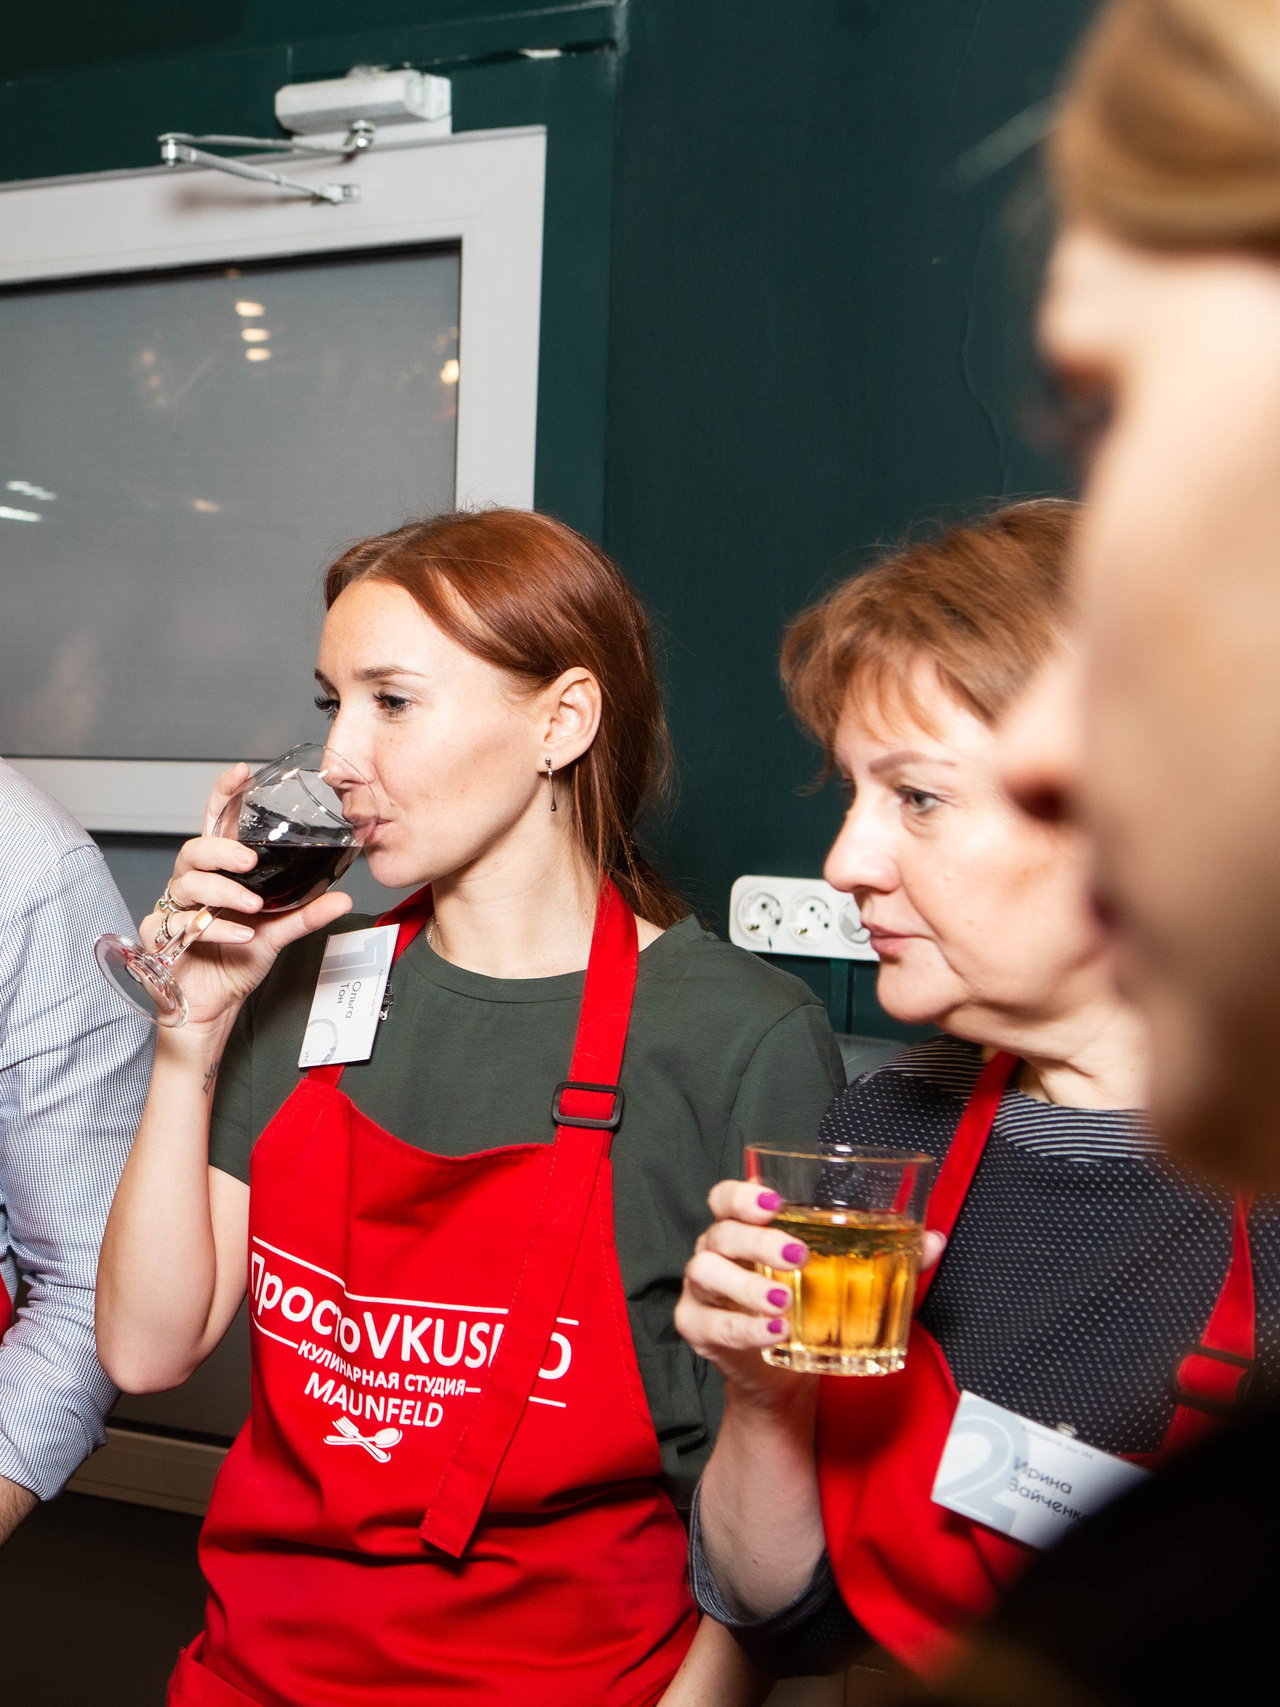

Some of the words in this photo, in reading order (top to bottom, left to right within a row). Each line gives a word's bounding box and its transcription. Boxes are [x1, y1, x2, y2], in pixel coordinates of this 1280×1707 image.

[336, 982, 350, 1004] Тон
[345, 981, 362, 1019] Ольга
[297, 1339, 399, 1390] КУЛИНАРНАЯ
[404, 1374, 466, 1398] СТУДИЯ
[304, 1372, 444, 1428] MAUNFELD
[1013, 1457, 1073, 1496] Ирина
